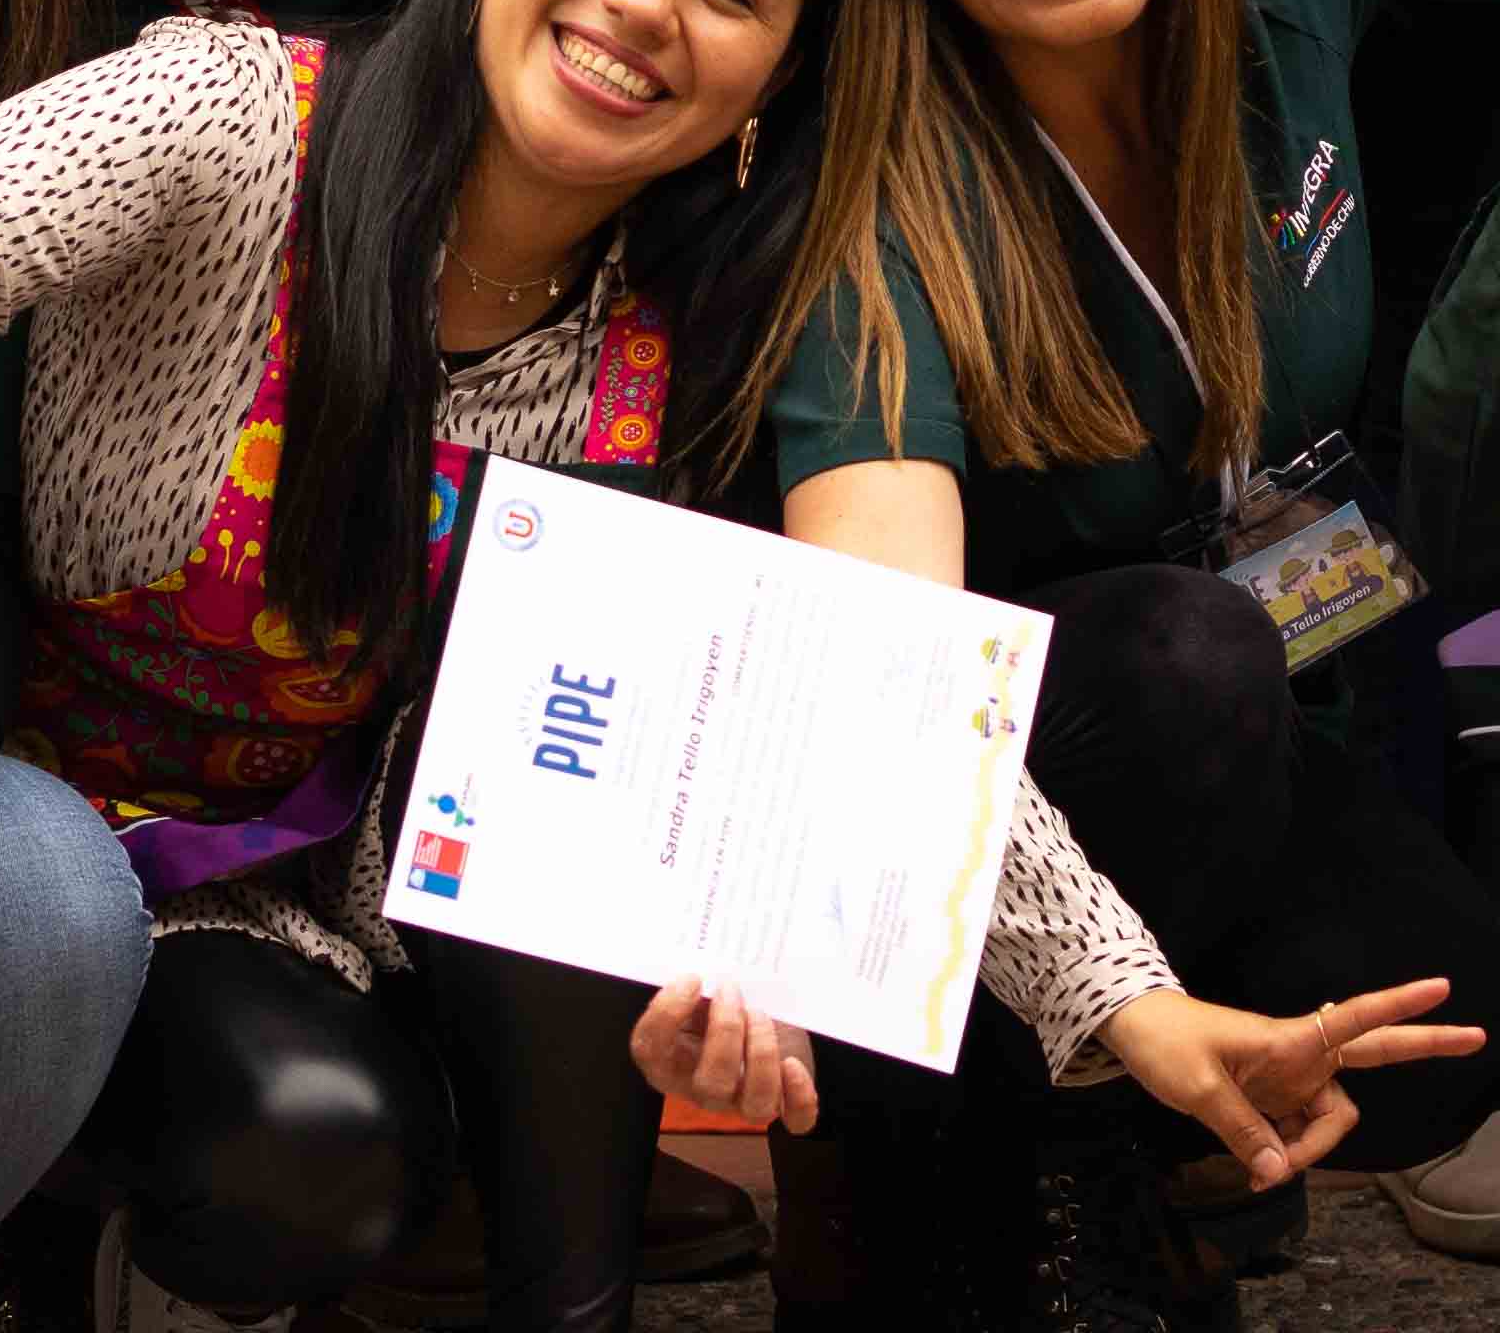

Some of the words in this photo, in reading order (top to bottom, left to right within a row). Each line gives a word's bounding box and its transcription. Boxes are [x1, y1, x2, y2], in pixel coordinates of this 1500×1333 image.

[1289, 139, 1339, 238] INTEGRA
[1304, 234, 1331, 288] GOBIERNO
[1326, 218, 1342, 239] DE
[1291, 612, 1321, 635] Tello
[1321, 583, 1371, 618] Irigoyen
[532, 663, 616, 779] PIPE
[659, 791, 689, 868] Sandra
[677, 732, 701, 781] Tello
[690, 634, 722, 726] Irigoyen
